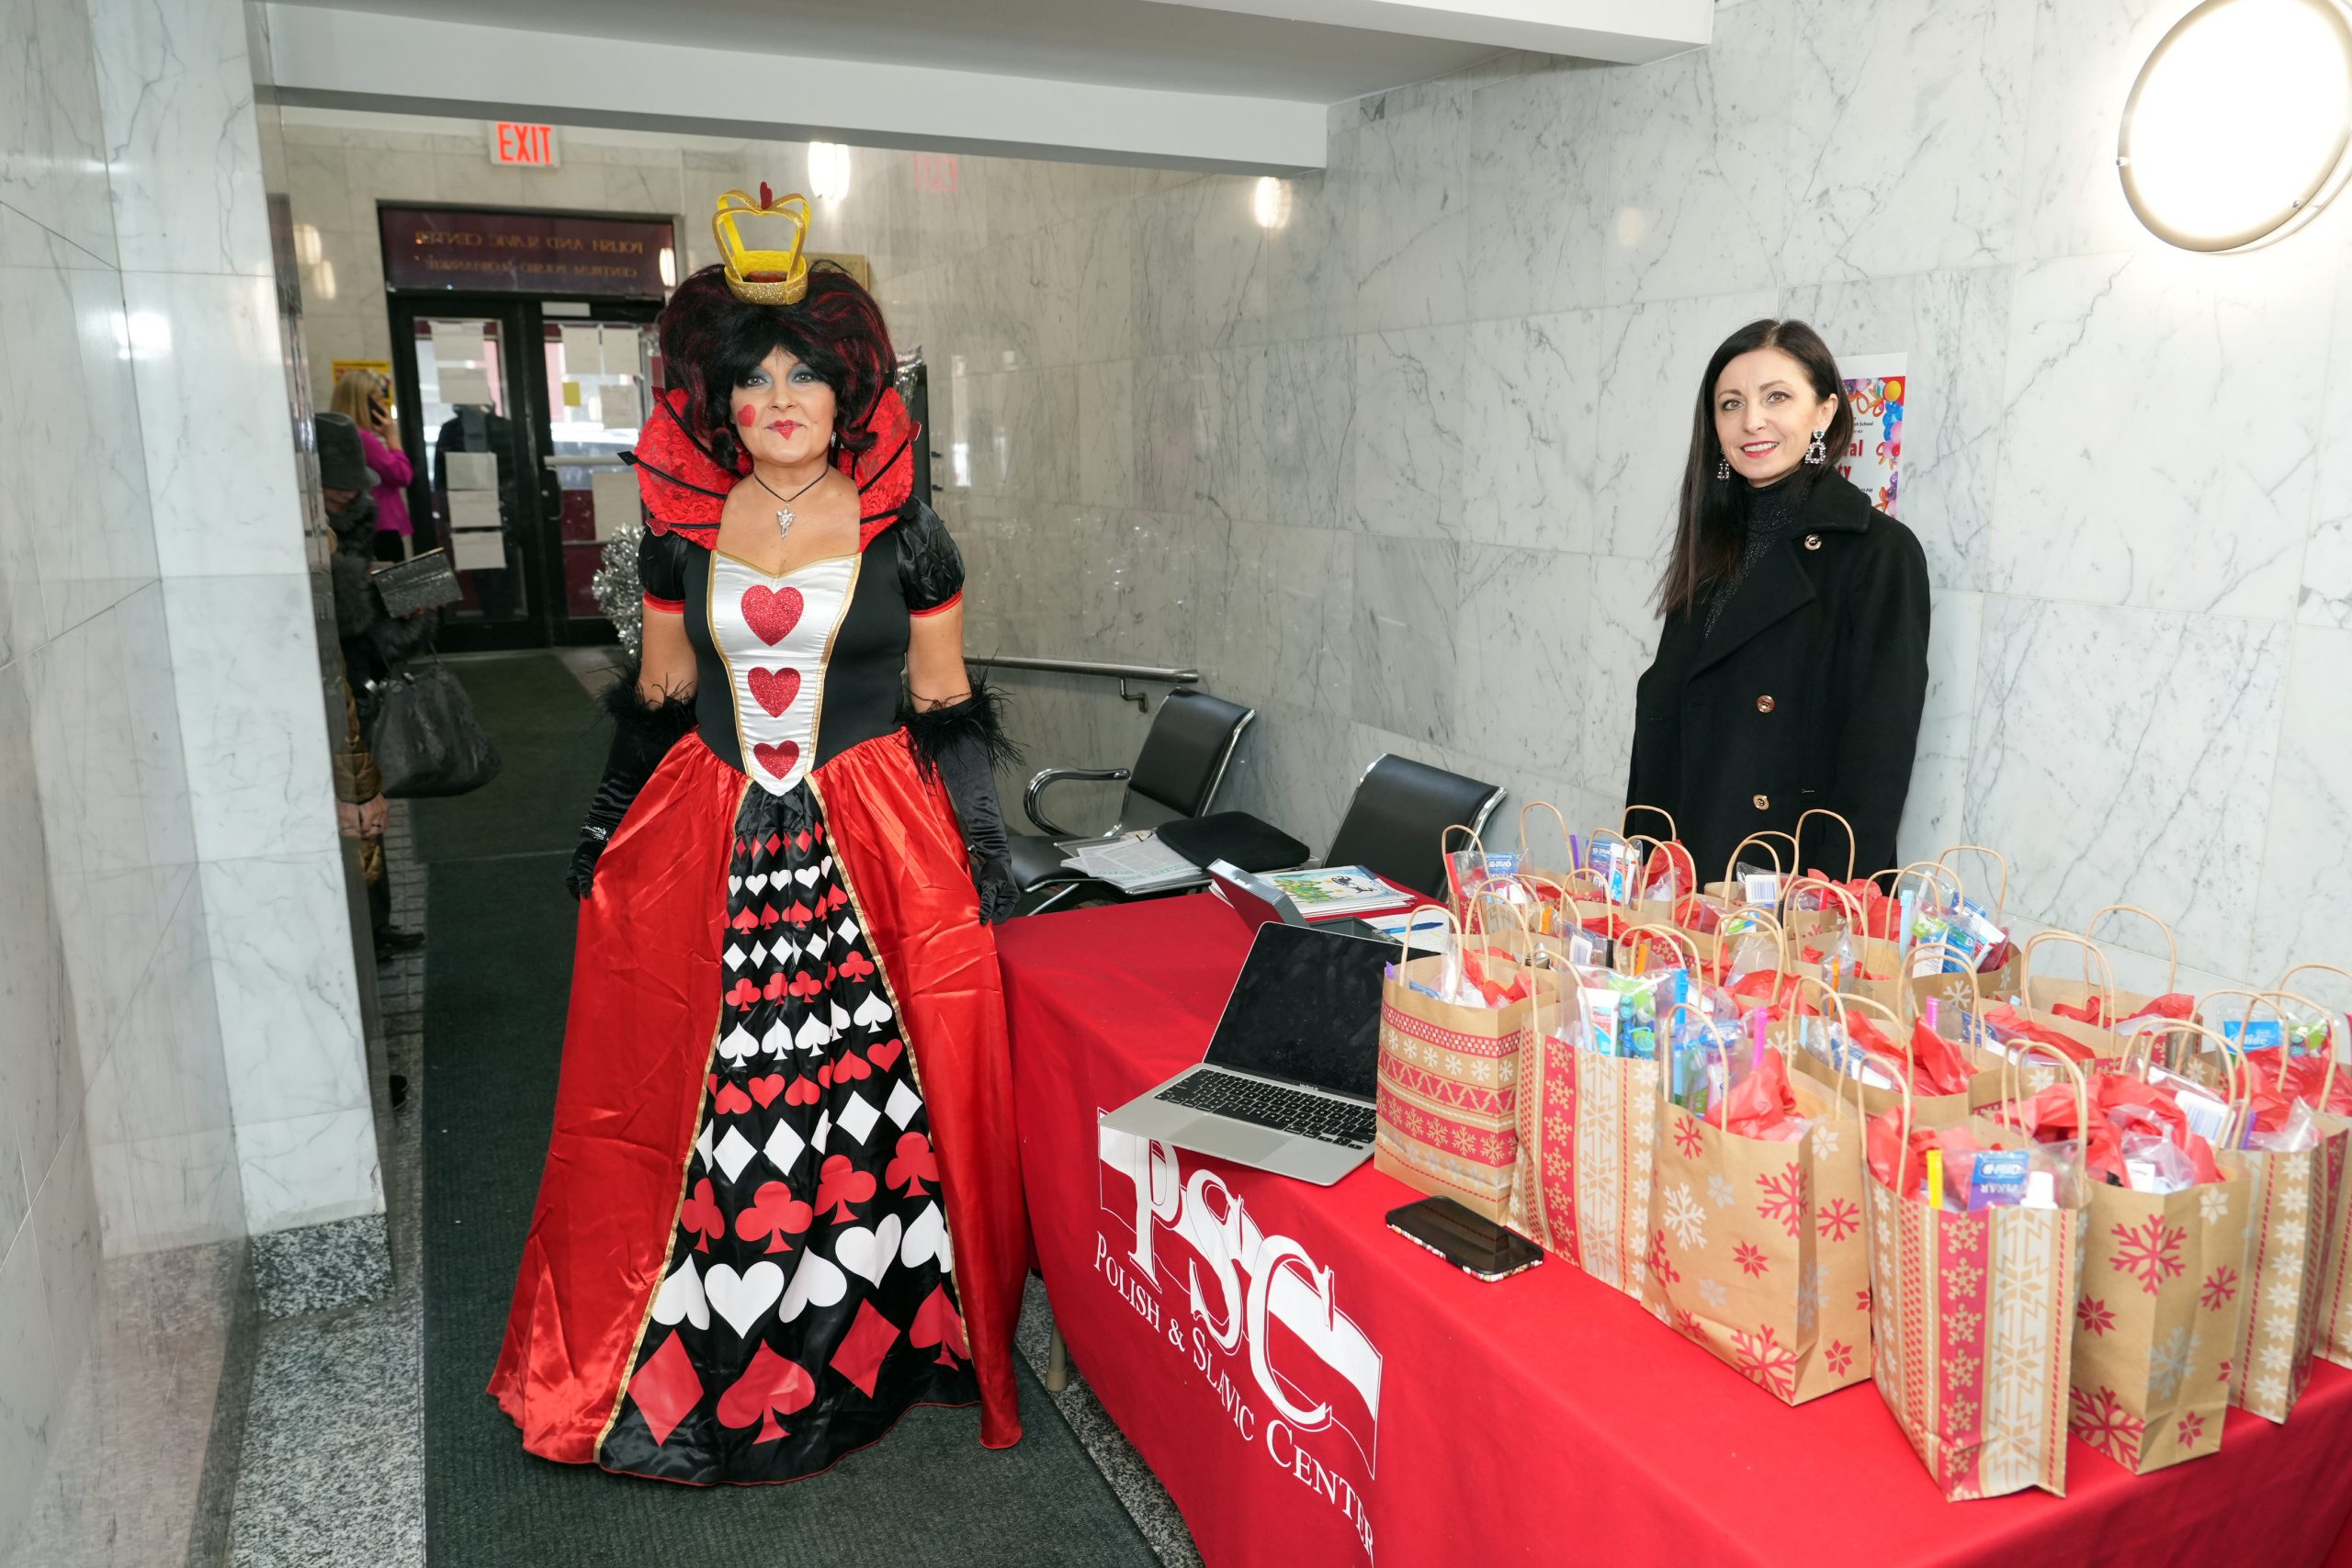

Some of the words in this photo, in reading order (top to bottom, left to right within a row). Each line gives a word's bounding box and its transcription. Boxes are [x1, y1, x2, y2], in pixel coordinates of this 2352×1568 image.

[497, 121, 551, 164] EXIT
[1094, 1231, 1160, 1333] POLISH
[1168, 1318, 1185, 1352] &
[1193, 1327, 1254, 1440] SLAVIC
[1267, 1419, 1374, 1568] CENTER
[1127, 1136, 1334, 1432] PSC
